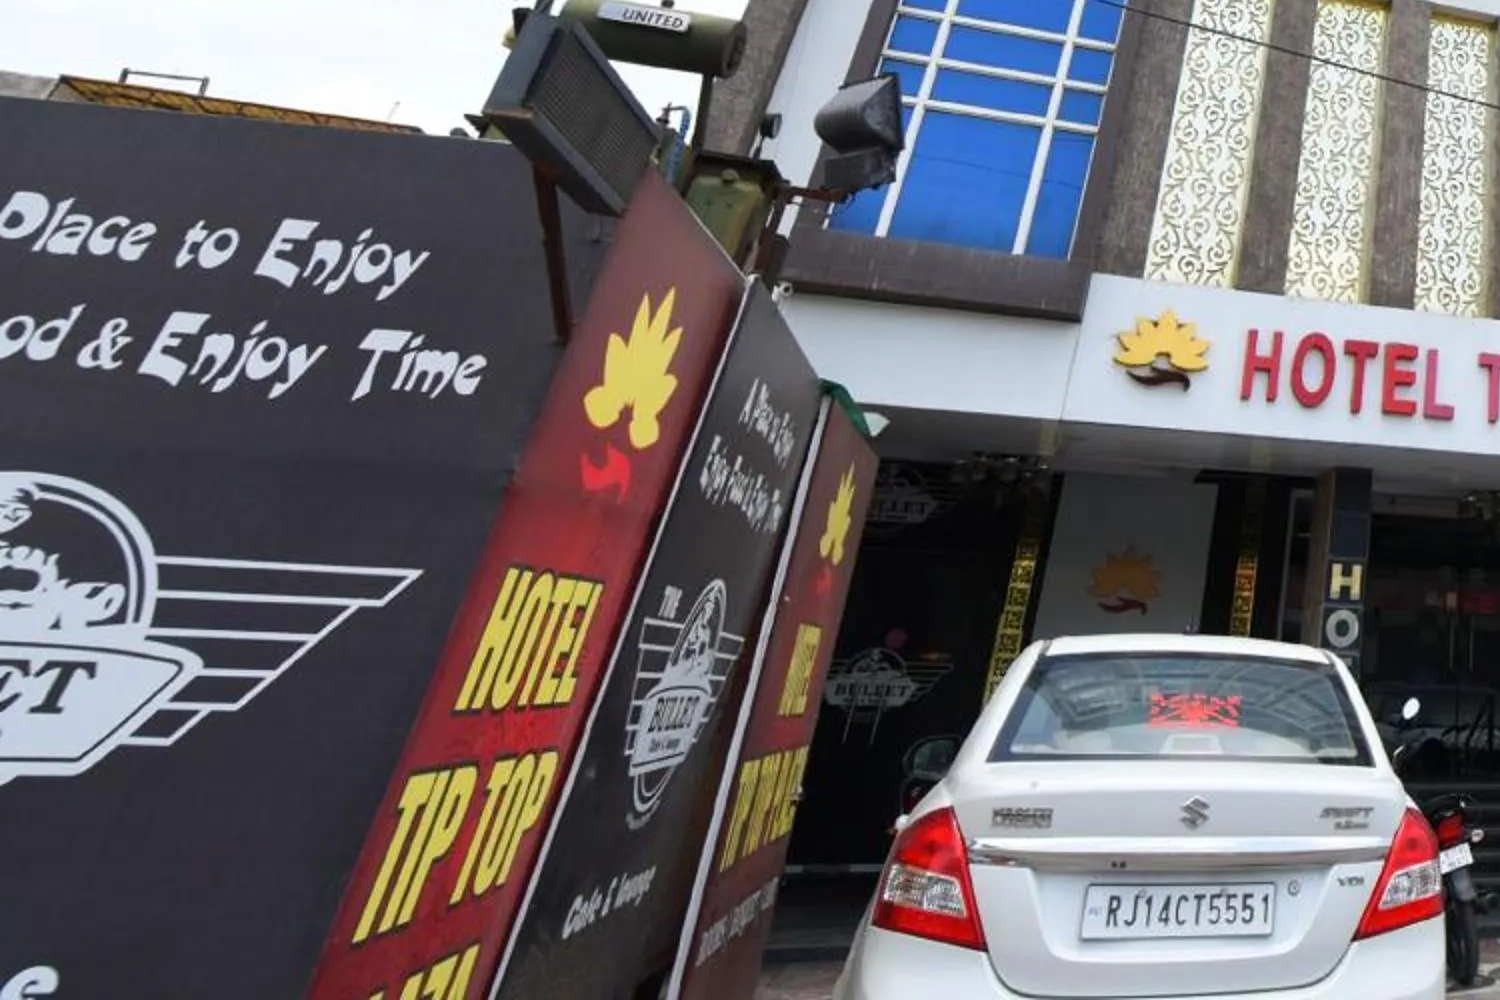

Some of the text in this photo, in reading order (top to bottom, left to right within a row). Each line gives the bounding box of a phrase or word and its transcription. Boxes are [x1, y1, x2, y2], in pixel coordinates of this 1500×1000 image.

[622, 7, 684, 29] UNITED
[174, 219, 240, 269] to
[254, 218, 431, 301] Enjoy
[76, 317, 134, 369] &
[138, 311, 328, 399] Enjoy
[352, 328, 488, 401] Time
[1239, 328, 1455, 421] HOTEL
[454, 567, 604, 711] HOTEL
[352, 765, 479, 944] TIP
[449, 750, 559, 906] TOP
[1106, 893, 1270, 929] RJ14CT5551
